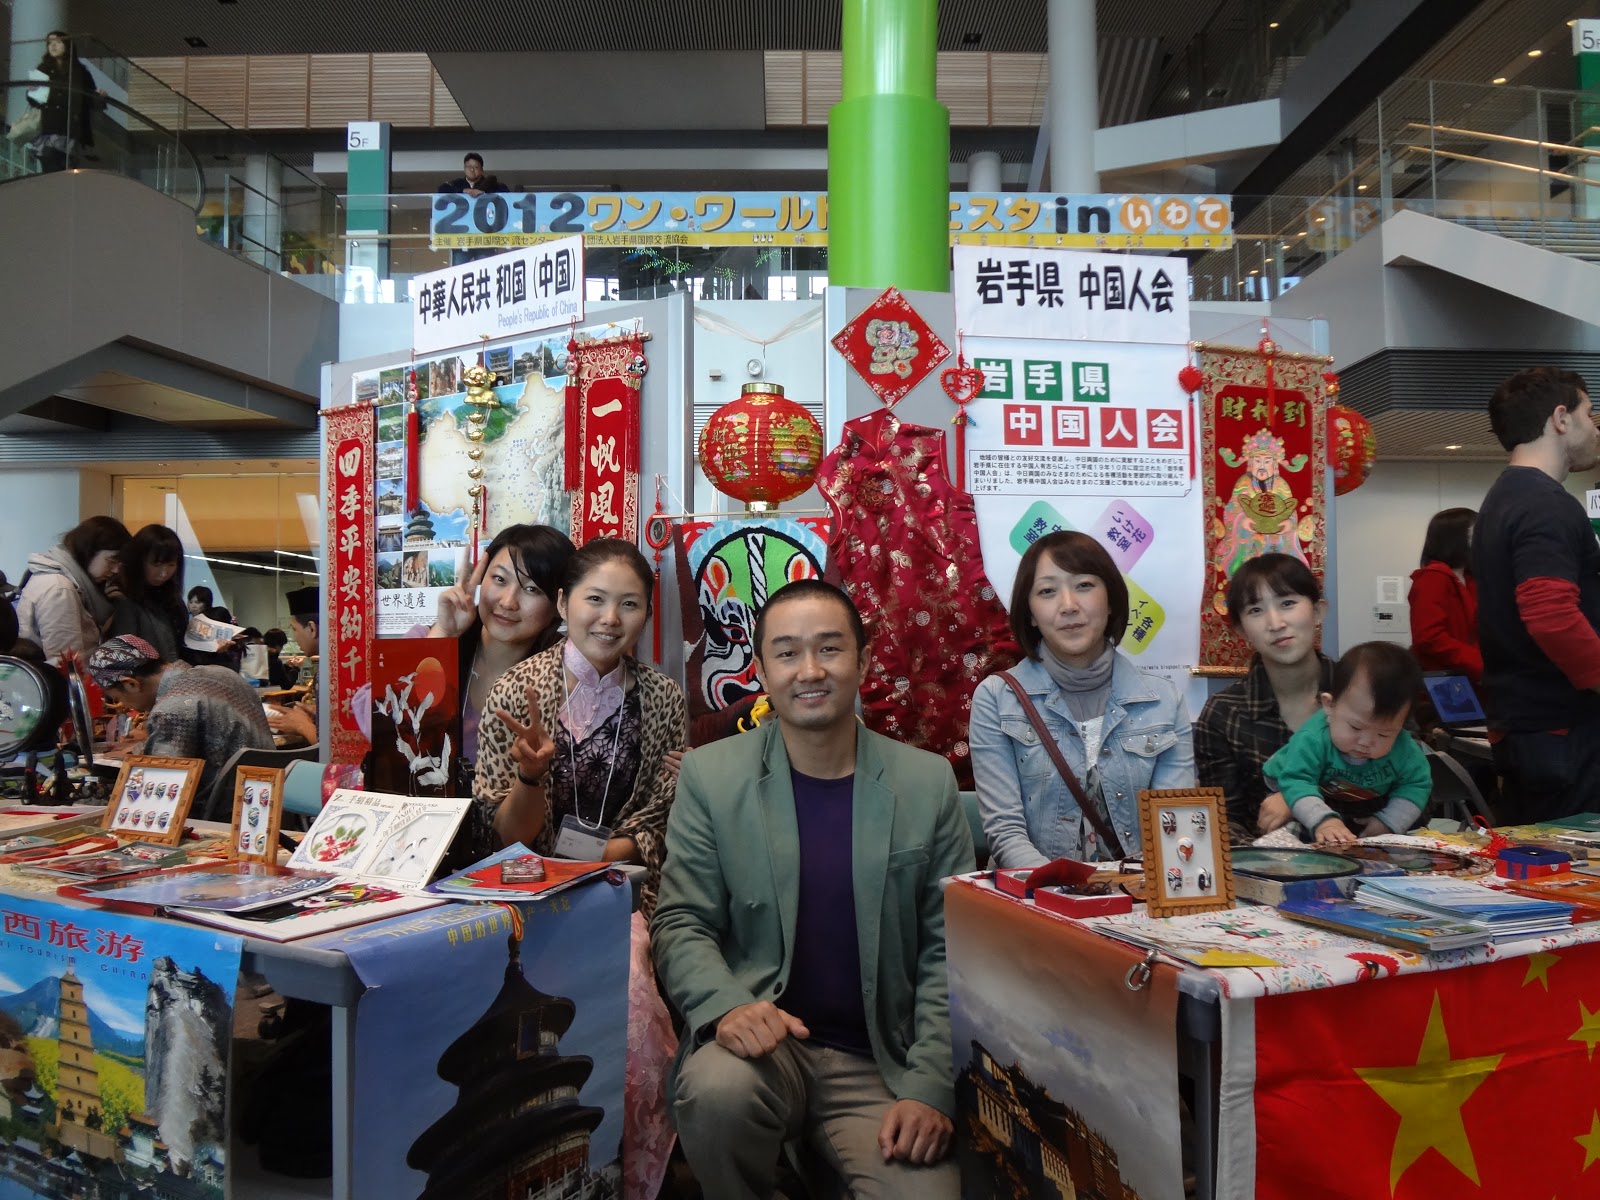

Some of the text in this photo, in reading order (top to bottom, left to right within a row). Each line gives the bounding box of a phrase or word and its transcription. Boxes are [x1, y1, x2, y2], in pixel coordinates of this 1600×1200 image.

[349, 131, 369, 148] 5F
[976, 258, 1174, 313] 岩手県 中国人会
[498, 299, 577, 328] People's Republic of China
[981, 361, 1107, 396] 岩手県
[1009, 407, 1178, 443] 中国人会
[588, 398, 623, 539] 一帆風
[1106, 526, 1131, 552] 教室
[1112, 510, 1147, 543] いけ花
[1, 909, 144, 962] 西旅游
[19, 944, 77, 964] TOURISM
[101, 964, 147, 981] CHINA
